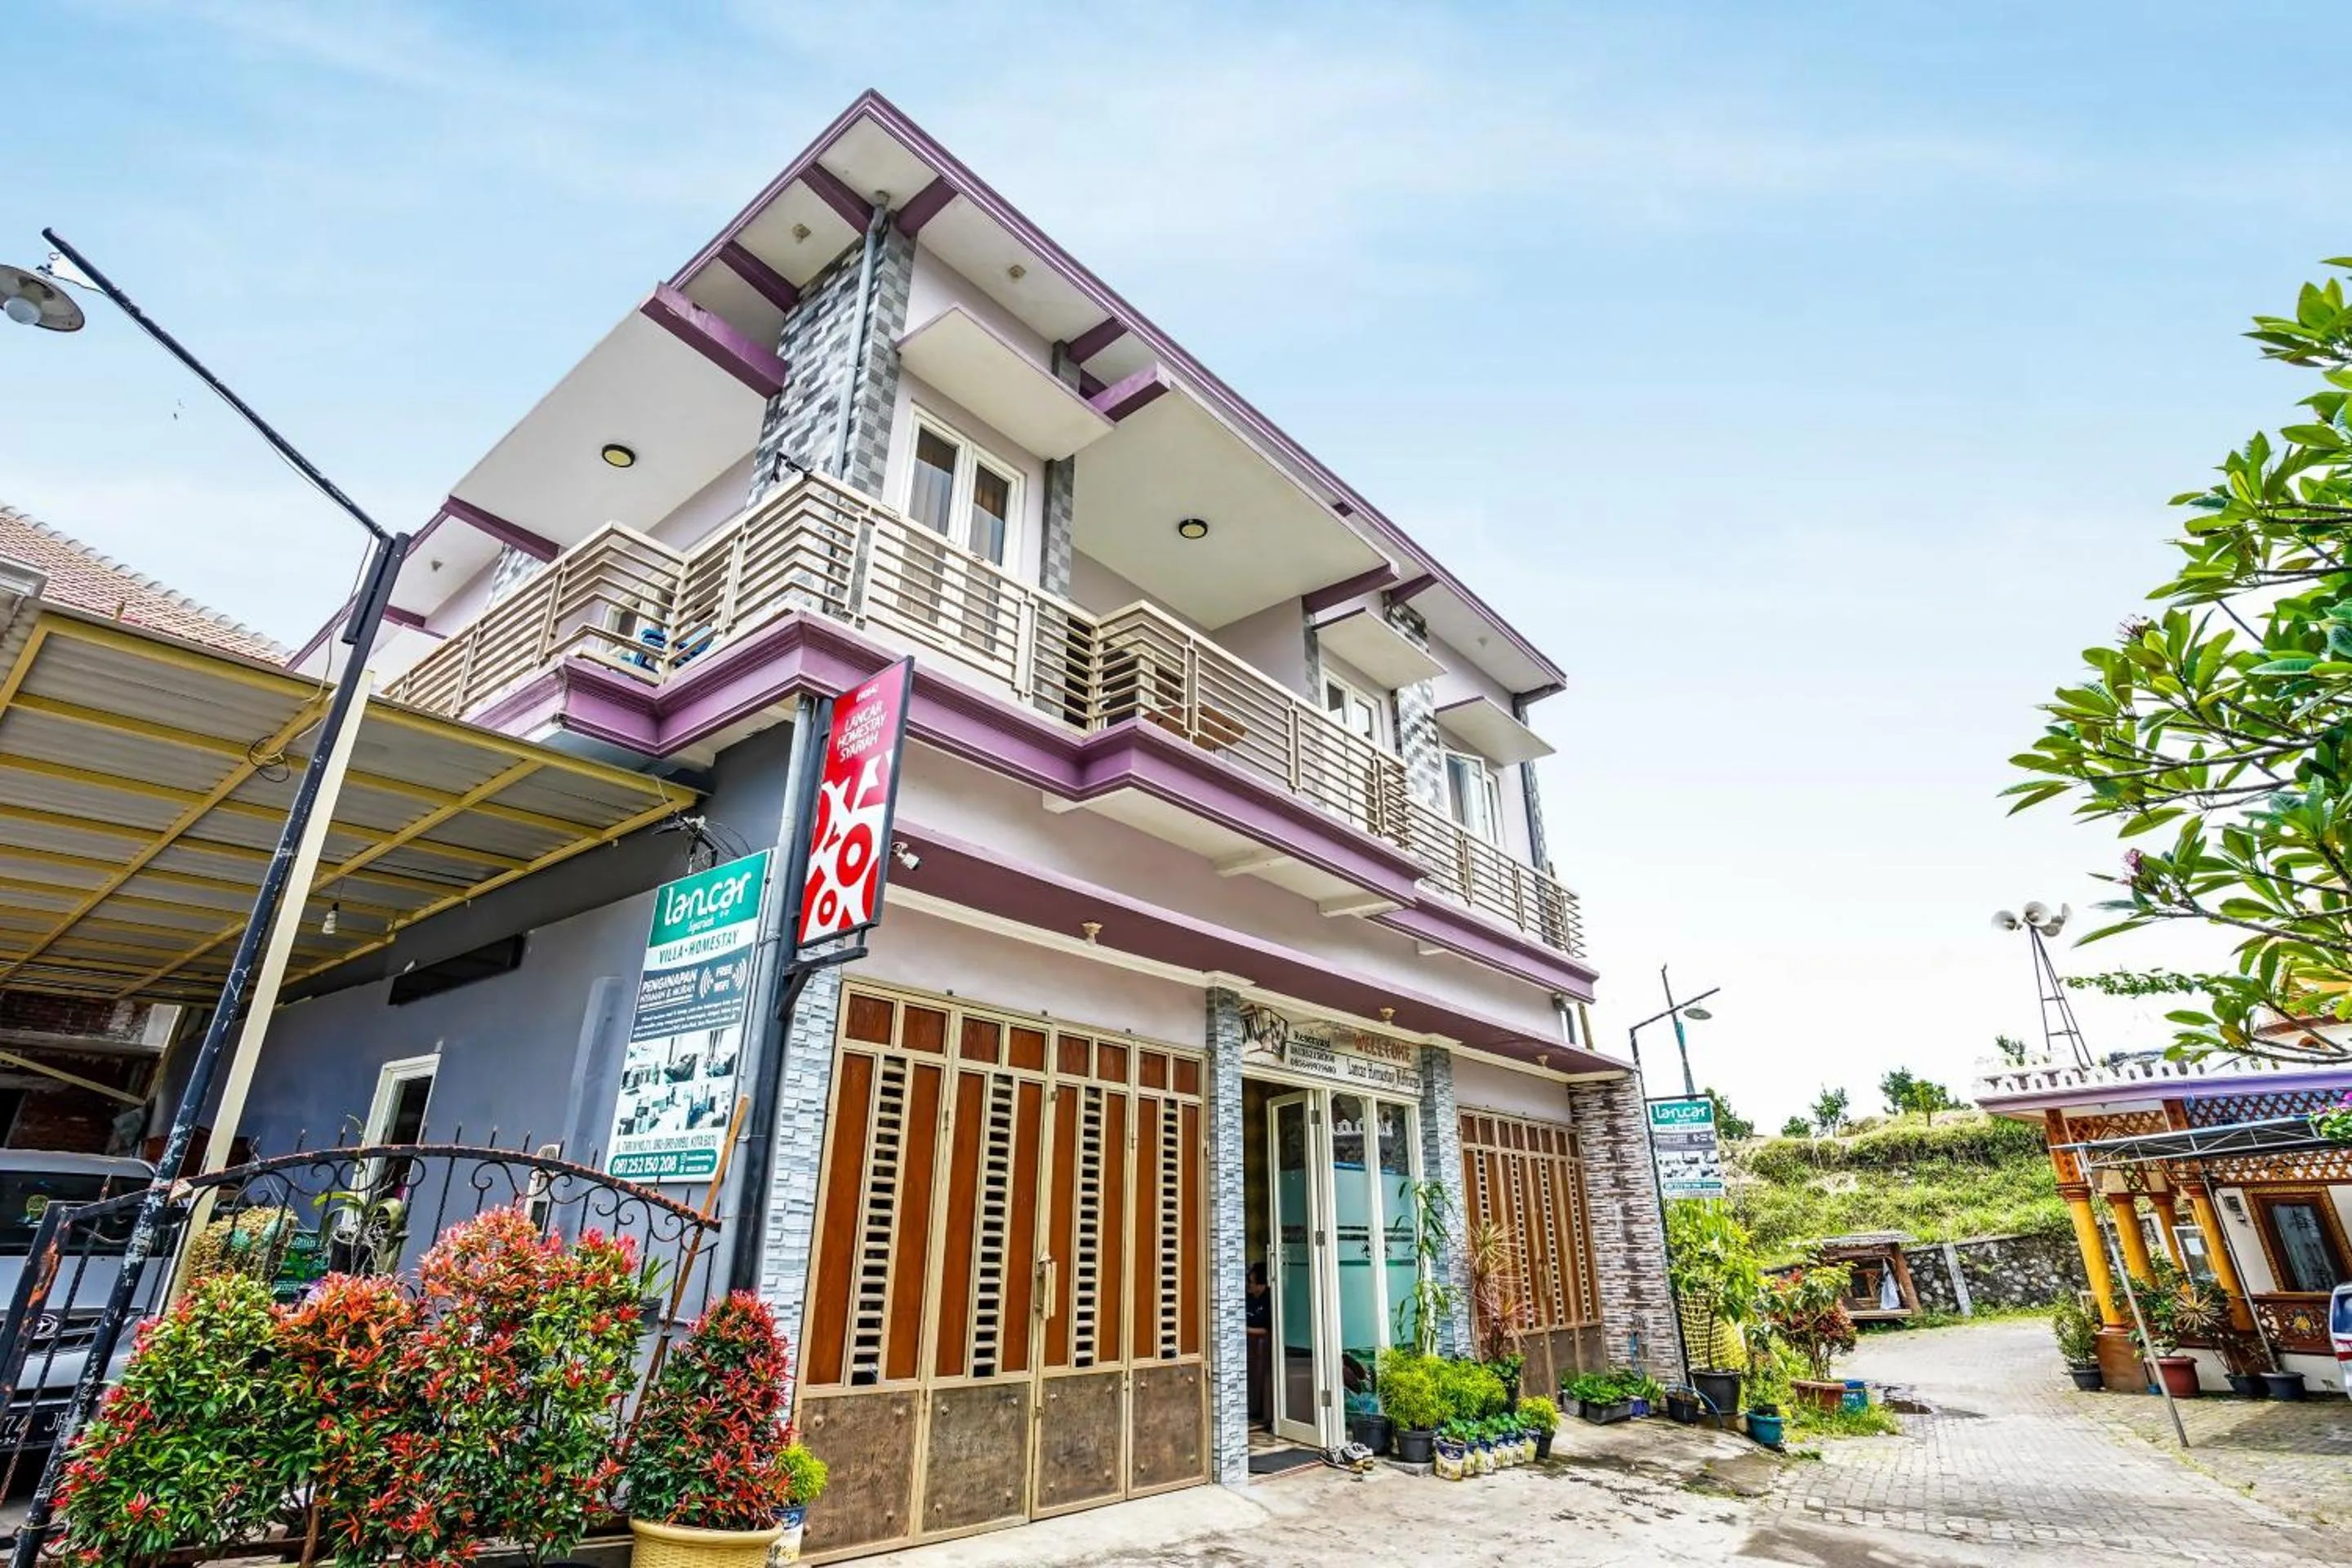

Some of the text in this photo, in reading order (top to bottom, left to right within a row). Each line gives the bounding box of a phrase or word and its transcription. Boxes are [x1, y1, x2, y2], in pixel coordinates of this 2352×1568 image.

[837, 711, 888, 751] HOMESTAY
[844, 700, 883, 733] LANCAR
[659, 929, 740, 964] VILLA HOMESTAY
[642, 969, 698, 992] PENGINAPAN
[715, 964, 733, 978] FREE
